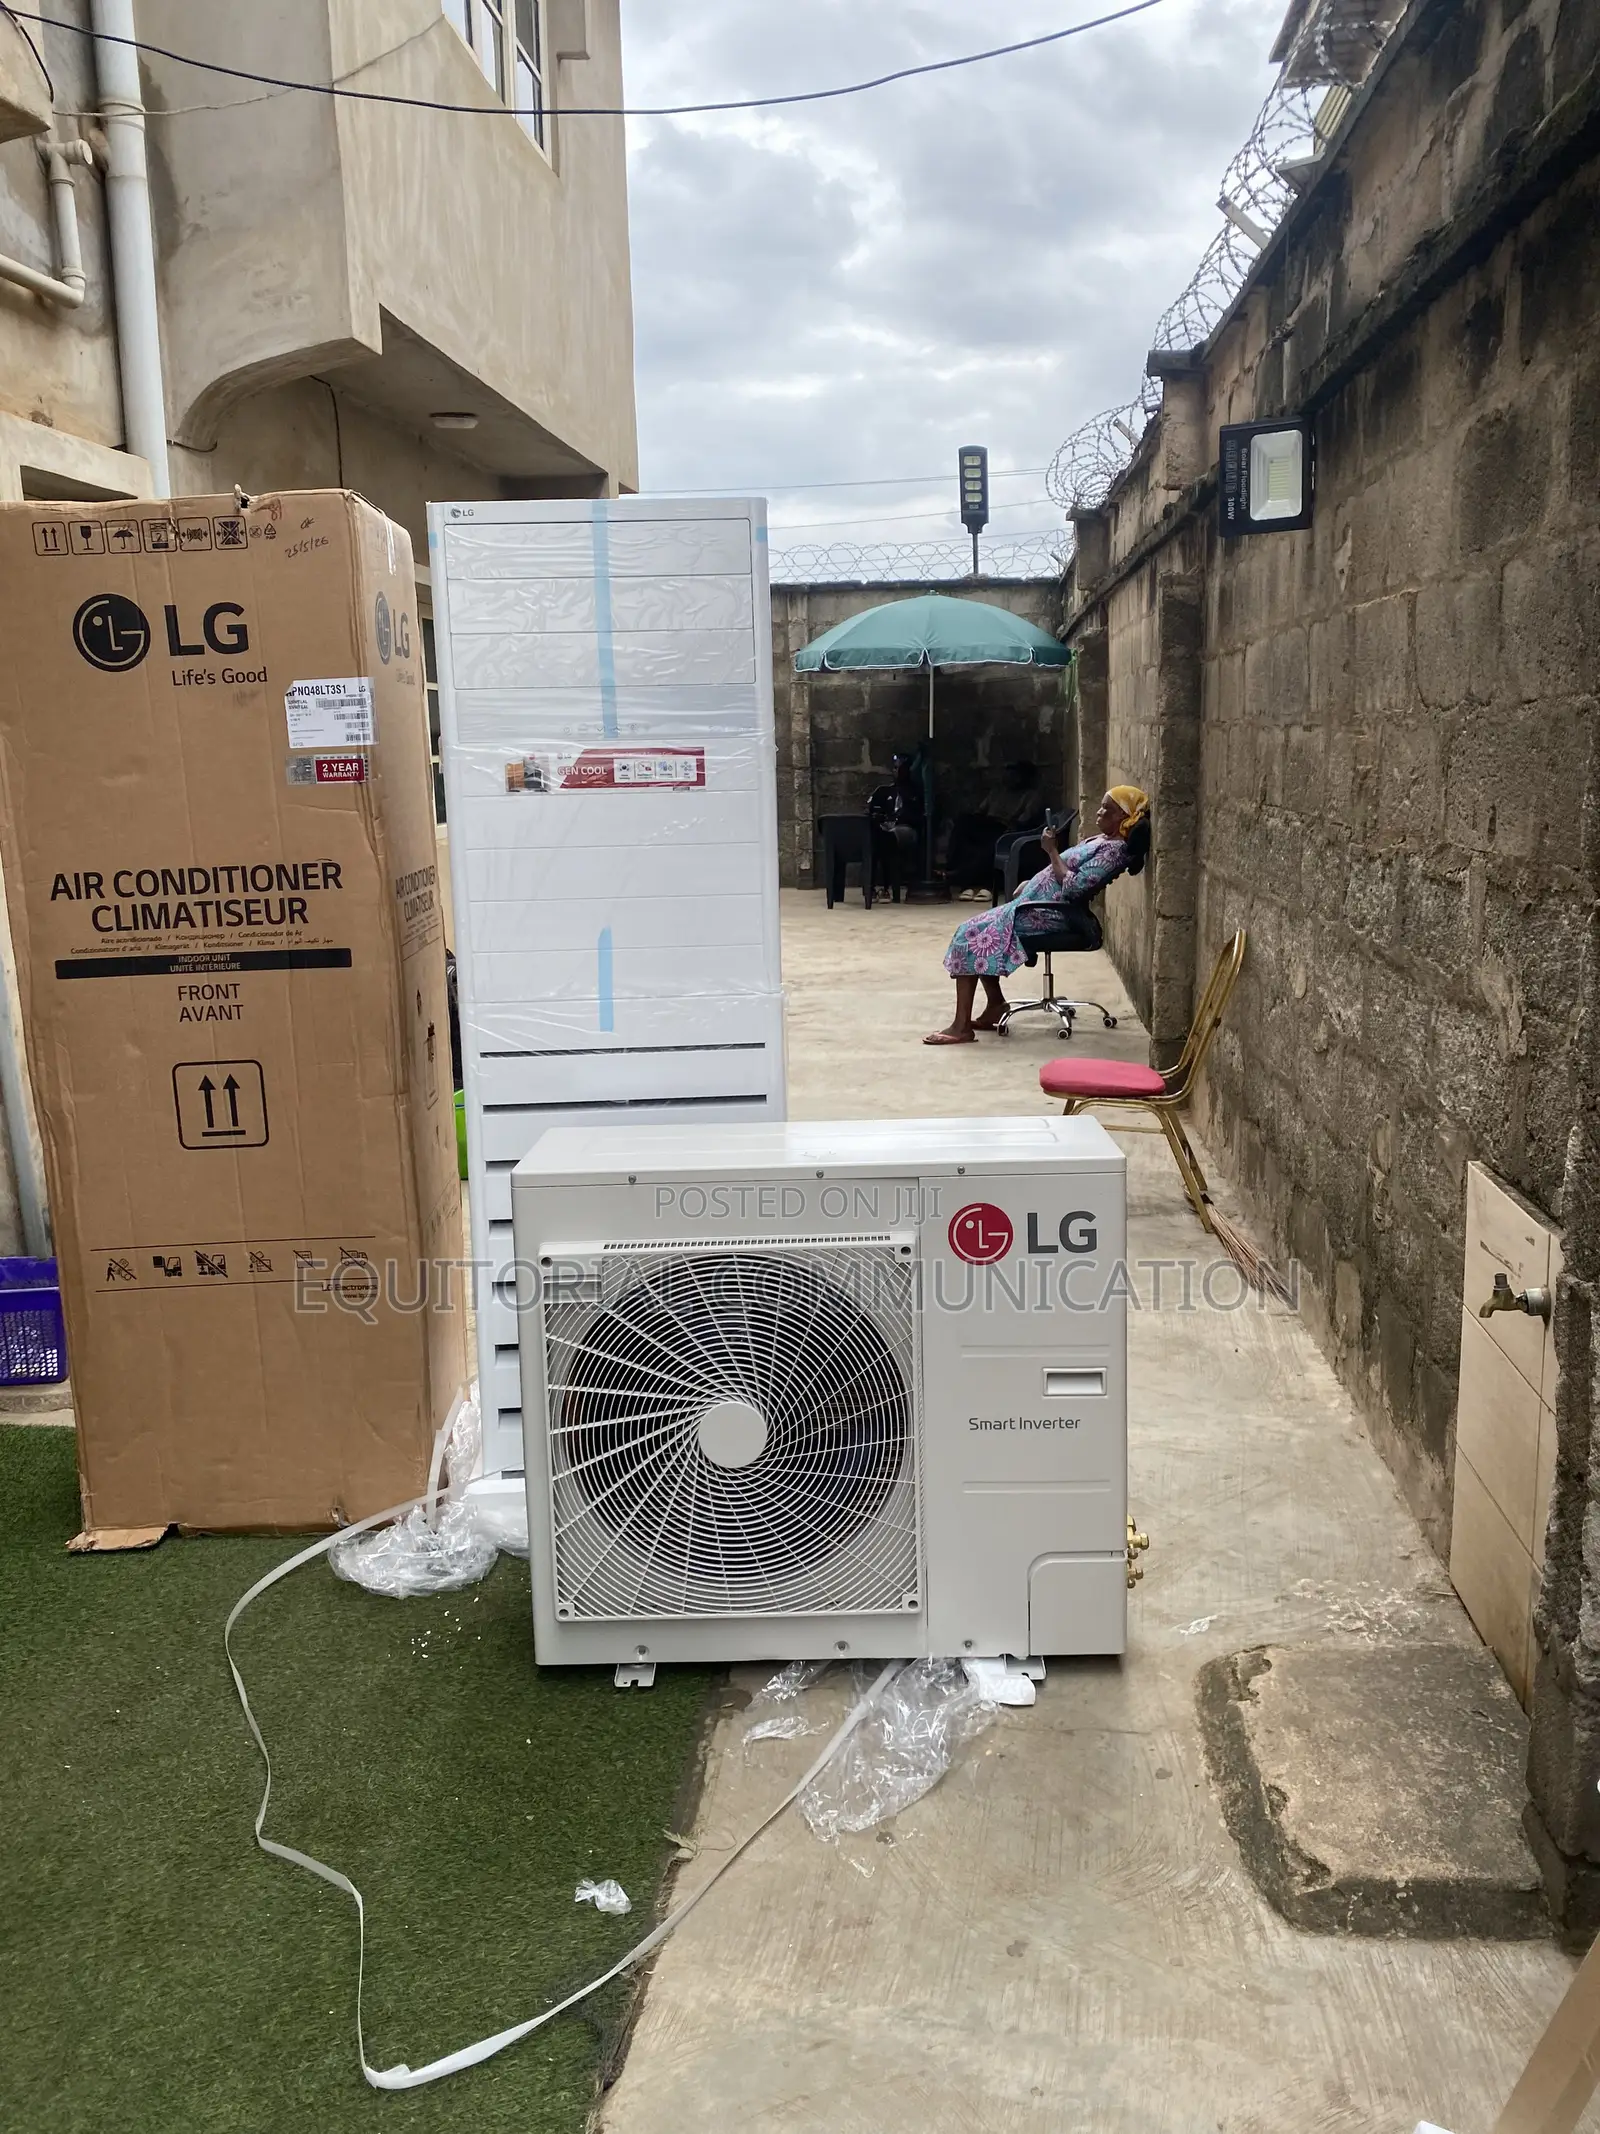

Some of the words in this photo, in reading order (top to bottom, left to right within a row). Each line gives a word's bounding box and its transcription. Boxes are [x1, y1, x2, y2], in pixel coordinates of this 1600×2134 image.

[164, 602, 250, 656] LG
[393, 608, 410, 658] LG
[172, 668, 216, 686] Life's
[222, 666, 268, 684] Good
[322, 764, 328, 772] 2
[332, 762, 359, 771] YEAR
[558, 766, 578, 775] GEN
[581, 766, 607, 775] COOL
[51, 872, 105, 900] AIR
[113, 862, 343, 898] CONDITIONER
[92, 896, 309, 932] CLIMATISEUR
[170, 963, 194, 972] UNITÉ
[195, 961, 242, 971] INTÉRIEURE
[178, 955, 210, 963] INDOOR
[212, 954, 231, 962] UNIT
[177, 983, 241, 1001] FRONT
[179, 1004, 244, 1023] AVANT
[1027, 1210, 1098, 1254] LG
[968, 1417, 1016, 1430] Smart
[1019, 1417, 1081, 1430] Inverter
